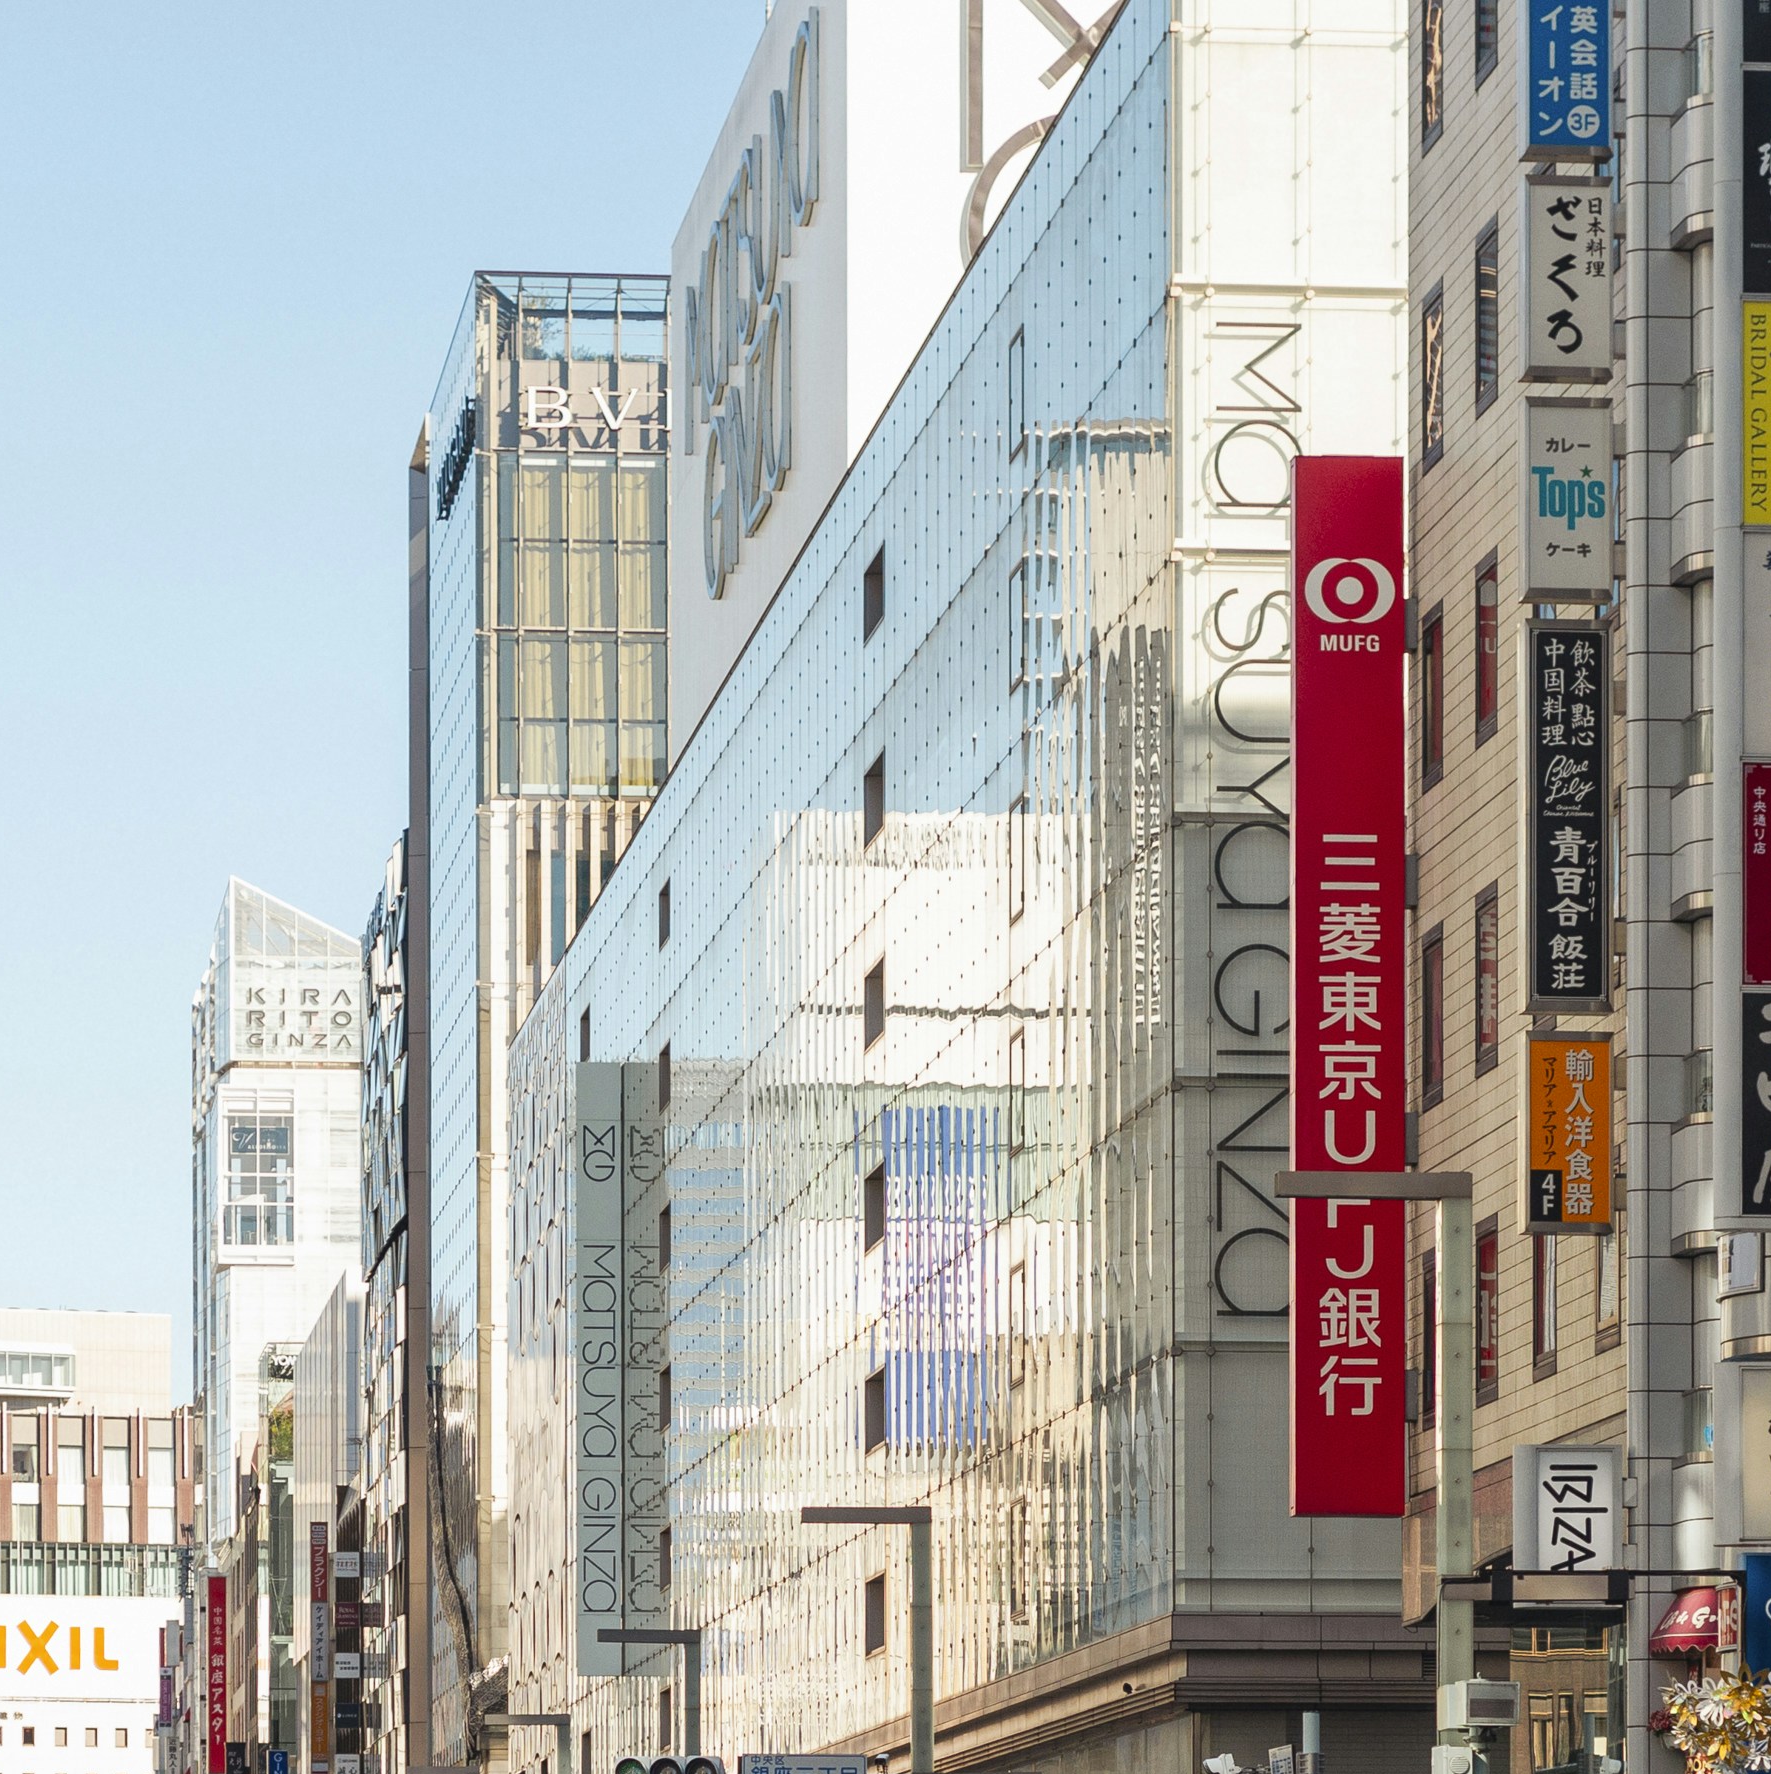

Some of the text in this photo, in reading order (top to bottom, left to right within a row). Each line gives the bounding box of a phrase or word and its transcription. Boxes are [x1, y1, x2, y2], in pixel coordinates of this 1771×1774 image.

[1539, 3, 1564, 136] イーオン
[1569, 5, 1599, 100] 英会話
[1585, 197, 1607, 278] 日本料理
[1546, 195, 1584, 355] ざくろ
[1751, 313, 1768, 512] BRIDAL GALLERY
[1545, 437, 1592, 454] カレー
[1545, 541, 1593, 558] ケーキ
[1319, 634, 1381, 653] MUFG
[1541, 638, 1567, 747] 中国料理
[1545, 755, 1589, 787] Blue
[1545, 777, 1596, 804] Lily
[1752, 786, 1767, 855] 中央通り店
[245, 986, 353, 1007] KIRA
[245, 1009, 353, 1028] RITO
[245, 1031, 353, 1048] GINZA
[1564, 1049, 1595, 1216] 輸入洋食器
[1542, 1173, 1556, 1217] 4F
[211, 1653, 225, 1746] 銀座アスター
[750, 1755, 785, 1766] 中央区
